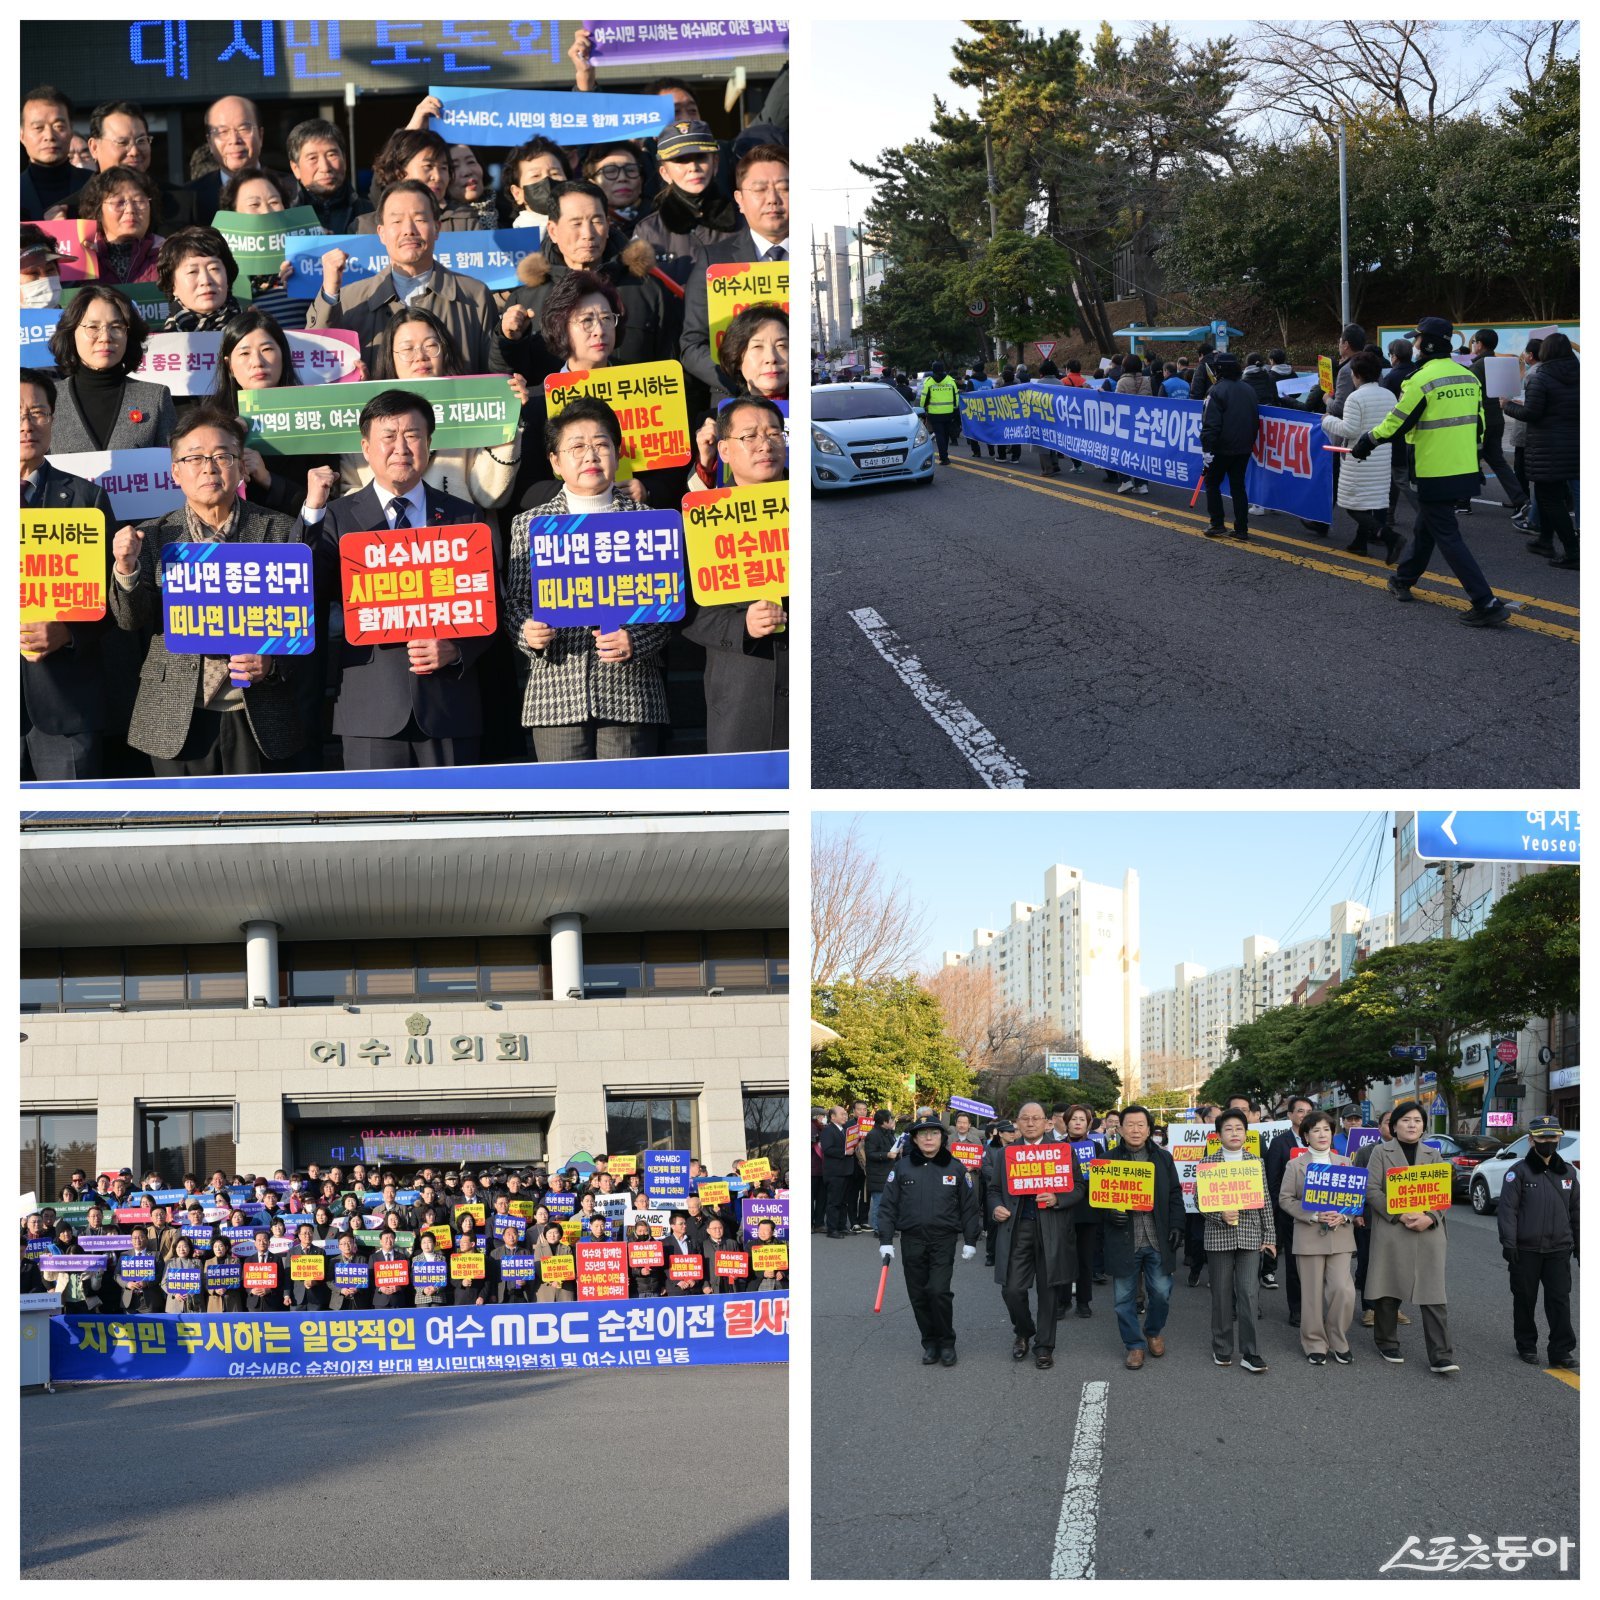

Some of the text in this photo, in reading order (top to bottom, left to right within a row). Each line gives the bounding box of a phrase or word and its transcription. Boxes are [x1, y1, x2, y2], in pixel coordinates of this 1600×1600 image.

[594, 25, 635, 43] 여수시민
[638, 25, 679, 42] 무시하는
[681, 20, 727, 39] 여수MBC
[442, 108, 661, 128] 여수MBC, 시민의 힘으로 함께 지켜요
[455, 251, 484, 269] 함께
[713, 275, 771, 297] 여수시민
[152, 353, 181, 371] 좋은
[310, 350, 345, 368] 친구!
[617, 375, 679, 400] 무시하는
[1437, 388, 1475, 400] POLICE
[250, 412, 291, 433] 지역의
[295, 410, 327, 431] 희망,
[448, 401, 507, 423] 지킵시다!
[1055, 394, 1083, 430] 여수
[639, 430, 685, 458] 반대!
[1121, 449, 1163, 476] 여수시민
[1163, 458, 1190, 483] 일동
[690, 500, 758, 528] 여수시민
[31, 523, 99, 545] 무시하는
[363, 538, 469, 569] 여수MBC
[533, 528, 680, 566] 만나면 좋은 친구!
[164, 561, 309, 594] 만나면 좋은 친구!
[349, 567, 489, 603] 시민의 힘으로
[697, 558, 786, 593] 이전 결사
[51, 582, 100, 608] 반대!
[537, 572, 679, 610] 떠나면 나쁜친구!
[169, 605, 309, 638] 떠나면 나쁜친구!
[357, 599, 484, 633] 함께지켜요!
[1184, 1130, 1200, 1143] 여수
[1015, 1149, 1062, 1162] 여수MBC
[1009, 1161, 1070, 1177] 시민의 힘으로
[1091, 1165, 1152, 1178] 여수시민 무시하는
[1199, 1167, 1259, 1179] 여수시민 무시하는
[1389, 1168, 1449, 1183] 여수시민 무시하는
[1013, 1177, 1068, 1190] 함께지켜요!
[1100, 1178, 1143, 1191] 여수MBC
[1209, 1180, 1252, 1193] 여수MBC
[1306, 1170, 1367, 1190] 만나면 좋은 친구!
[1398, 1182, 1440, 1196] 여수MBC
[1091, 1192, 1152, 1205] 이전 결사 반대!
[1201, 1195, 1220, 1206] 이전
[1221, 1193, 1239, 1206] 결사
[1304, 1189, 1329, 1204] 떠나면
[1389, 1193, 1449, 1208] 이전 결사 반대!
[752, 1204, 783, 1213] 여수 MBC
[647, 1215, 663, 1224] MBC
[582, 1248, 601, 1258] 여수와
[585, 1261, 606, 1271] 55년의
[607, 1261, 621, 1270] 역사
[592, 1275, 607, 1283] MBC
[77, 1320, 167, 1354] 지역민
[175, 1320, 291, 1354] 무시하는
[299, 1317, 416, 1351] 일방적인
[425, 1314, 485, 1349] 여수
[490, 1311, 590, 1346] MBC
[597, 1305, 715, 1344] 순천이전
[228, 1347, 690, 1377] 여수MBC 순천이전 반대 범시민대책위원회 및 여수시민 일동
